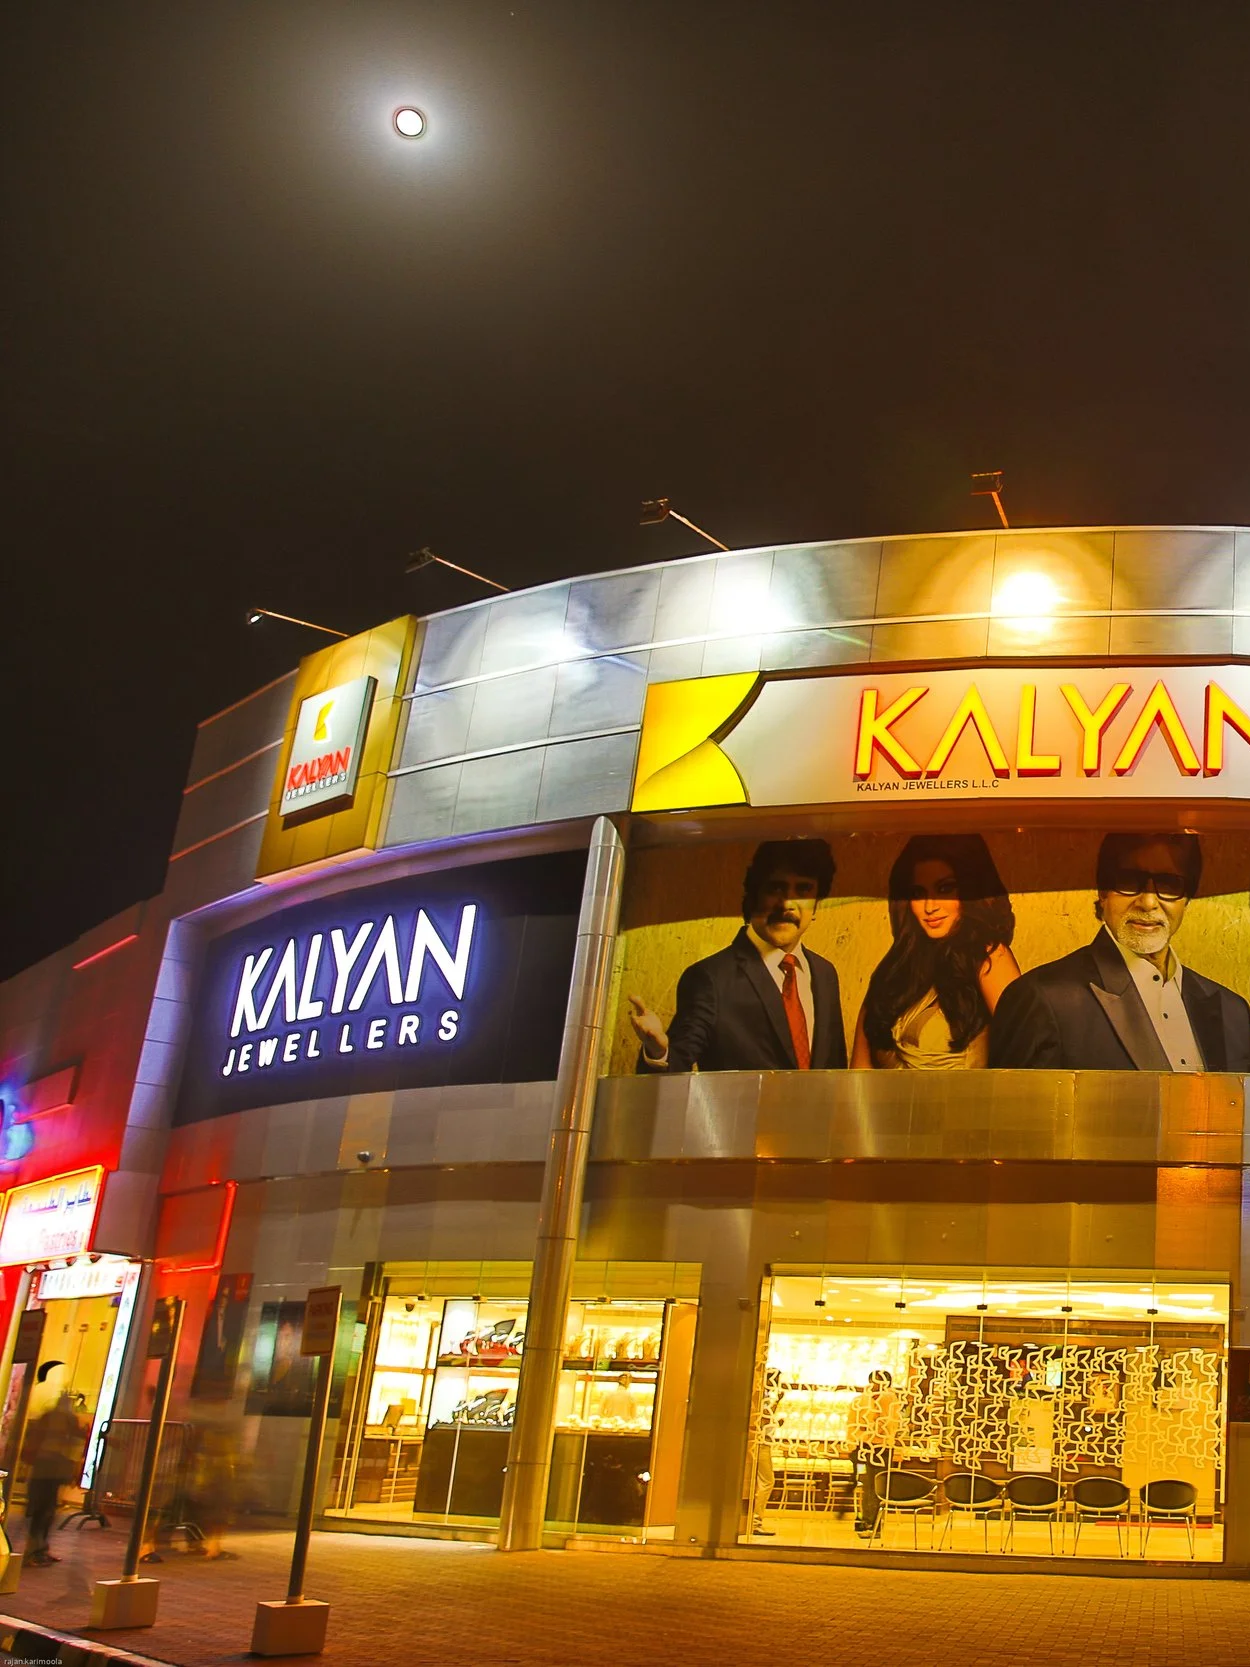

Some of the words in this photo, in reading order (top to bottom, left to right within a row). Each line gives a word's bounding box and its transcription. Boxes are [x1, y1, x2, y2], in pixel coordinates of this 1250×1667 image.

[286, 772, 346, 801] JEWELLERS
[287, 746, 351, 791] KALYAN
[857, 782, 899, 791] KALYAN
[902, 780, 968, 790] JEWELLERS
[972, 779, 999, 788] L.L.C
[230, 904, 478, 1037] KALYAN
[222, 1009, 459, 1077] JEWELLERS
